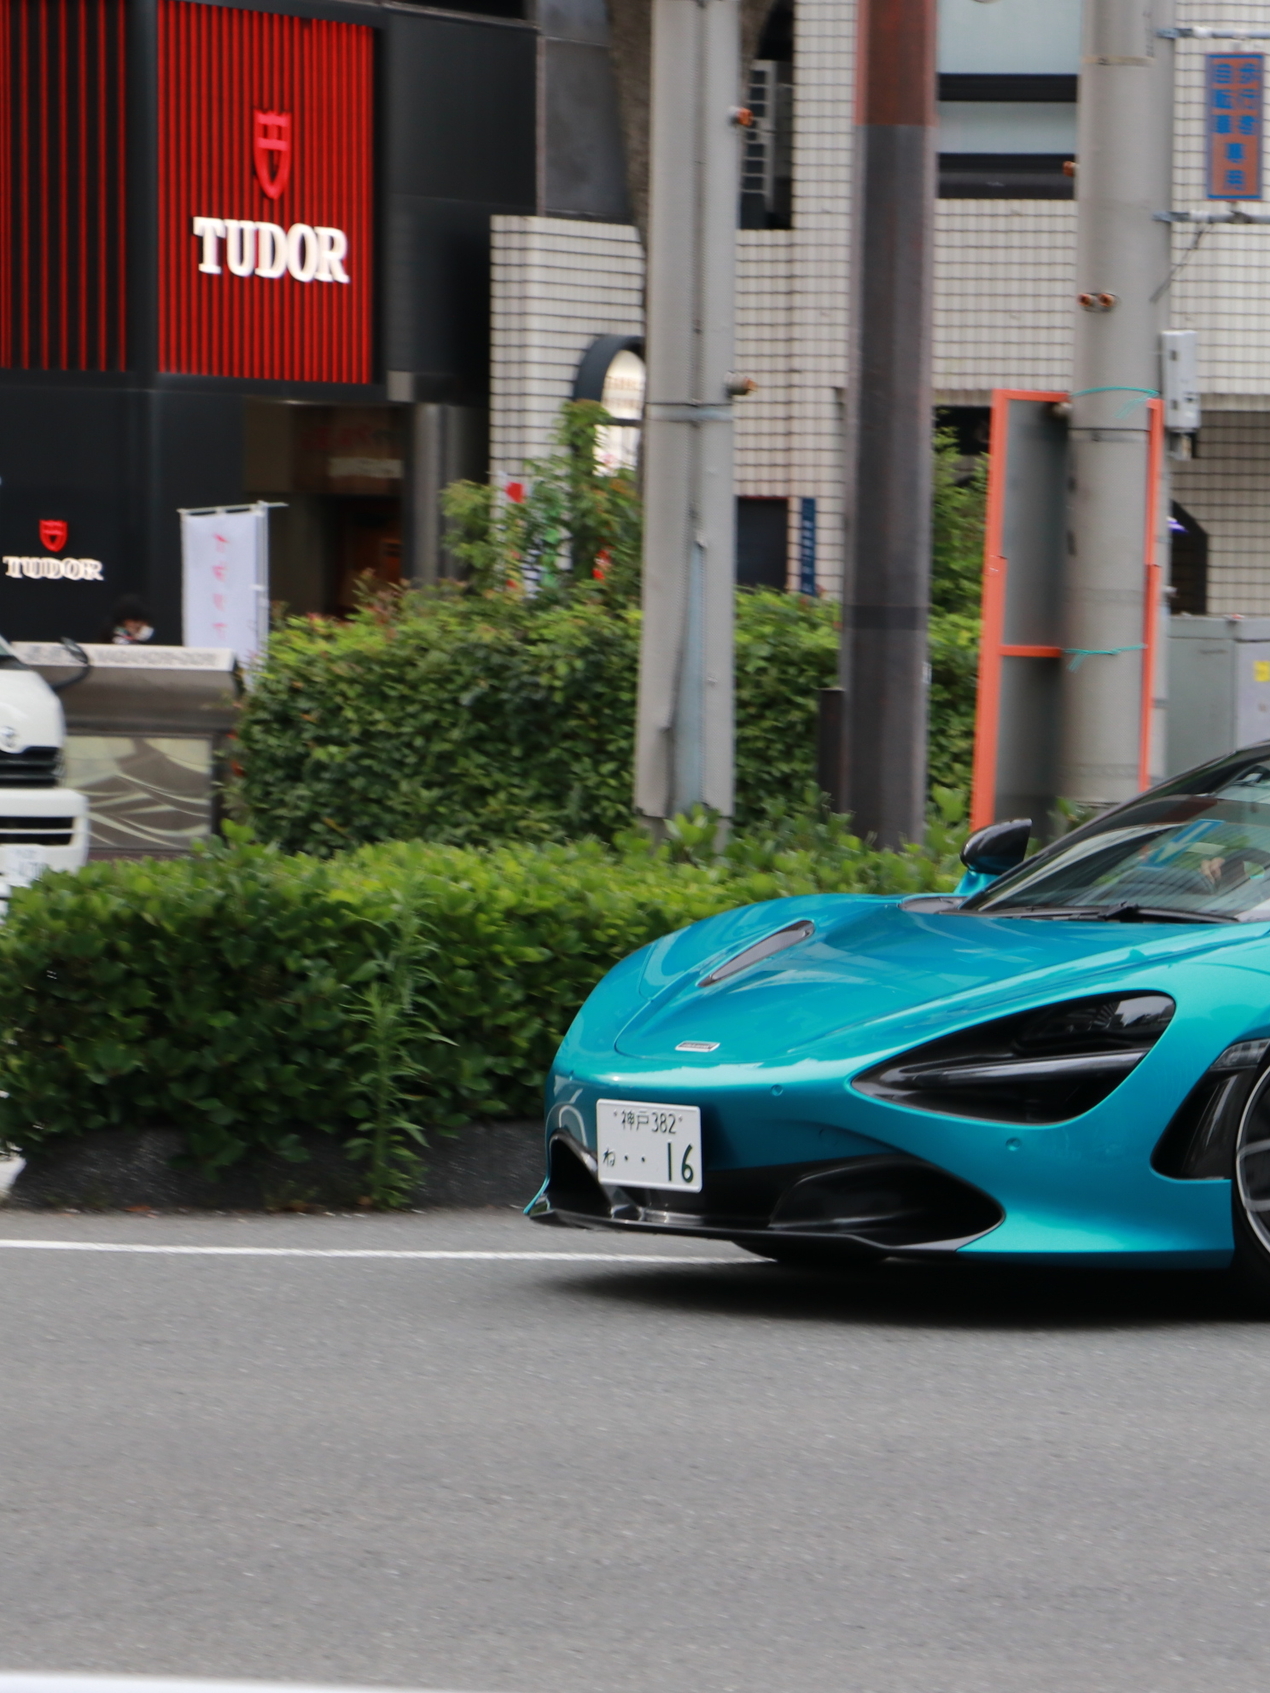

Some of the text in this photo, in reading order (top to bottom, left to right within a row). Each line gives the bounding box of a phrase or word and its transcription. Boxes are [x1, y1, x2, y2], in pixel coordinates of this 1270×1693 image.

[193, 216, 350, 284] TUDOR
[2, 555, 104, 581] TUDOR
[666, 1140, 694, 1184] 16
